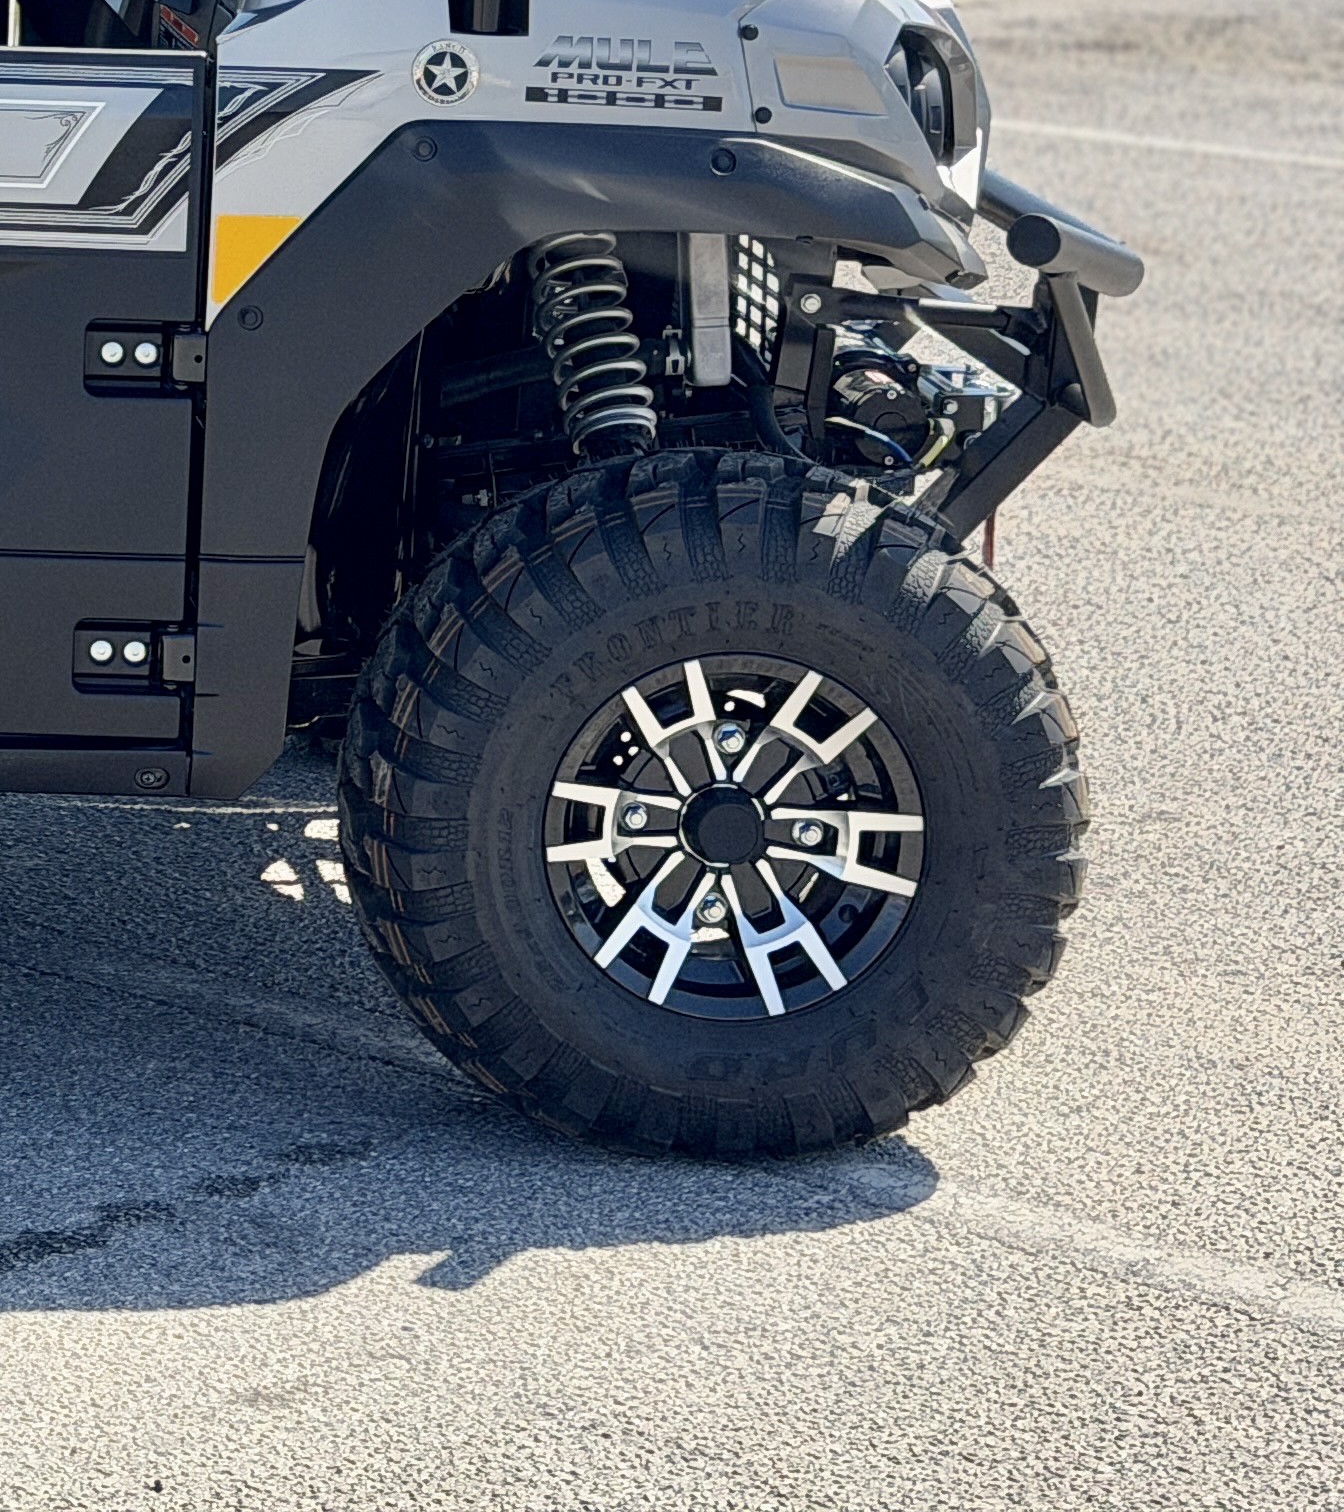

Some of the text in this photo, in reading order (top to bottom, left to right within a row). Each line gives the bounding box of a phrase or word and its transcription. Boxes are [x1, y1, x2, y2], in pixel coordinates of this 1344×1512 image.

[533, 35, 718, 76] MULE
[550, 71, 700, 90] PRO-FXT
[542, 87, 705, 110] 1000
